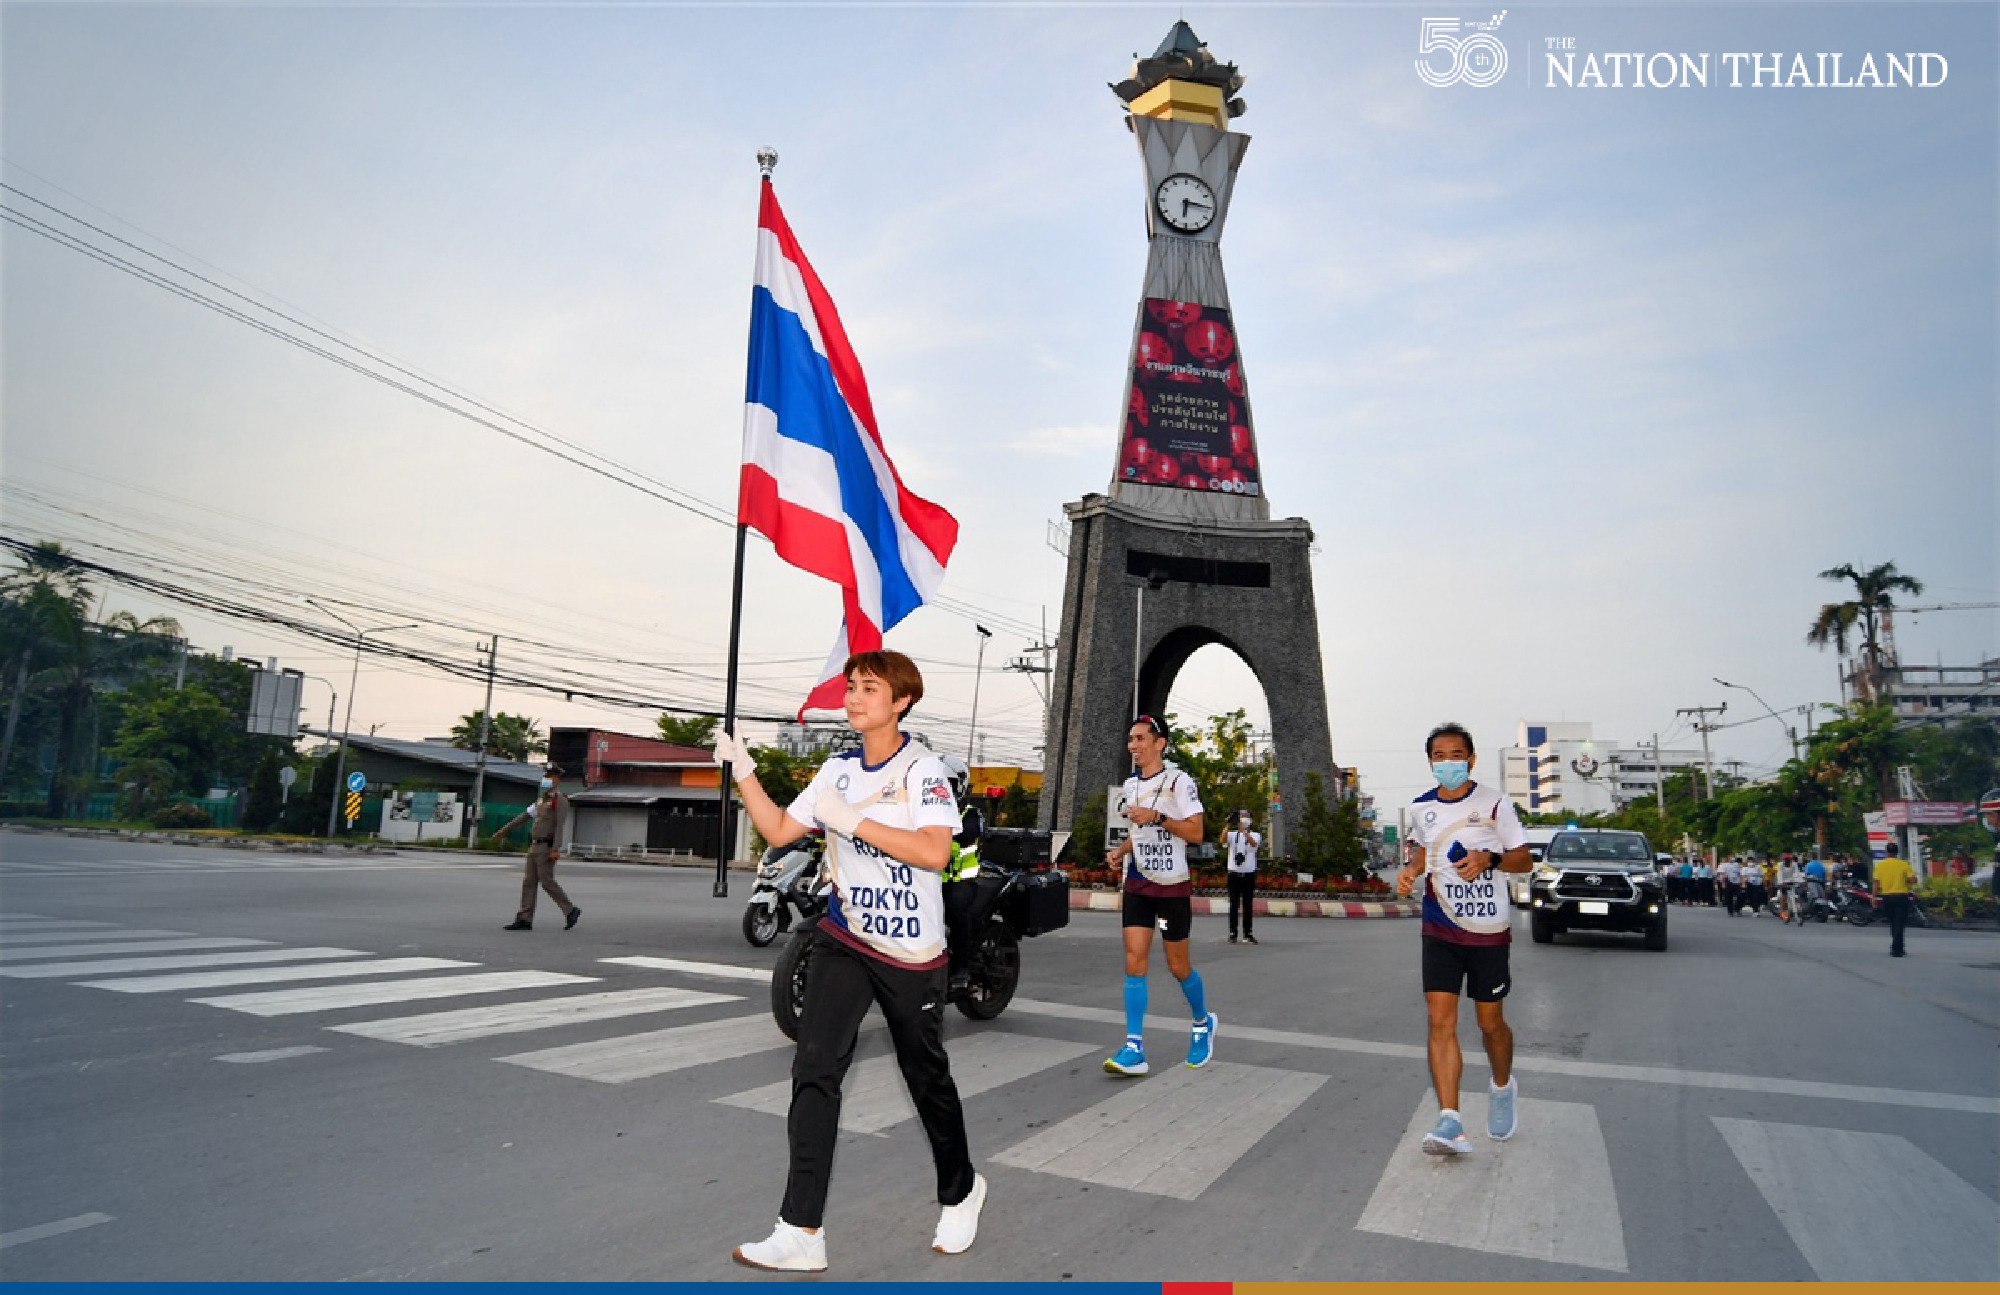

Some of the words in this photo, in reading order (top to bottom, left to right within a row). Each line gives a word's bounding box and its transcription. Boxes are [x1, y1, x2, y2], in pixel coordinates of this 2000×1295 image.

[1155, 829, 1173, 842] TO
[1137, 843, 1173, 857] TOKYO
[1144, 857, 1174, 872] 2020
[885, 862, 913, 888] TO
[849, 886, 919, 911] TOKYO
[1445, 883, 1494, 899] TOKYO
[1455, 901, 1497, 917] 2020
[862, 912, 921, 938] 2020
